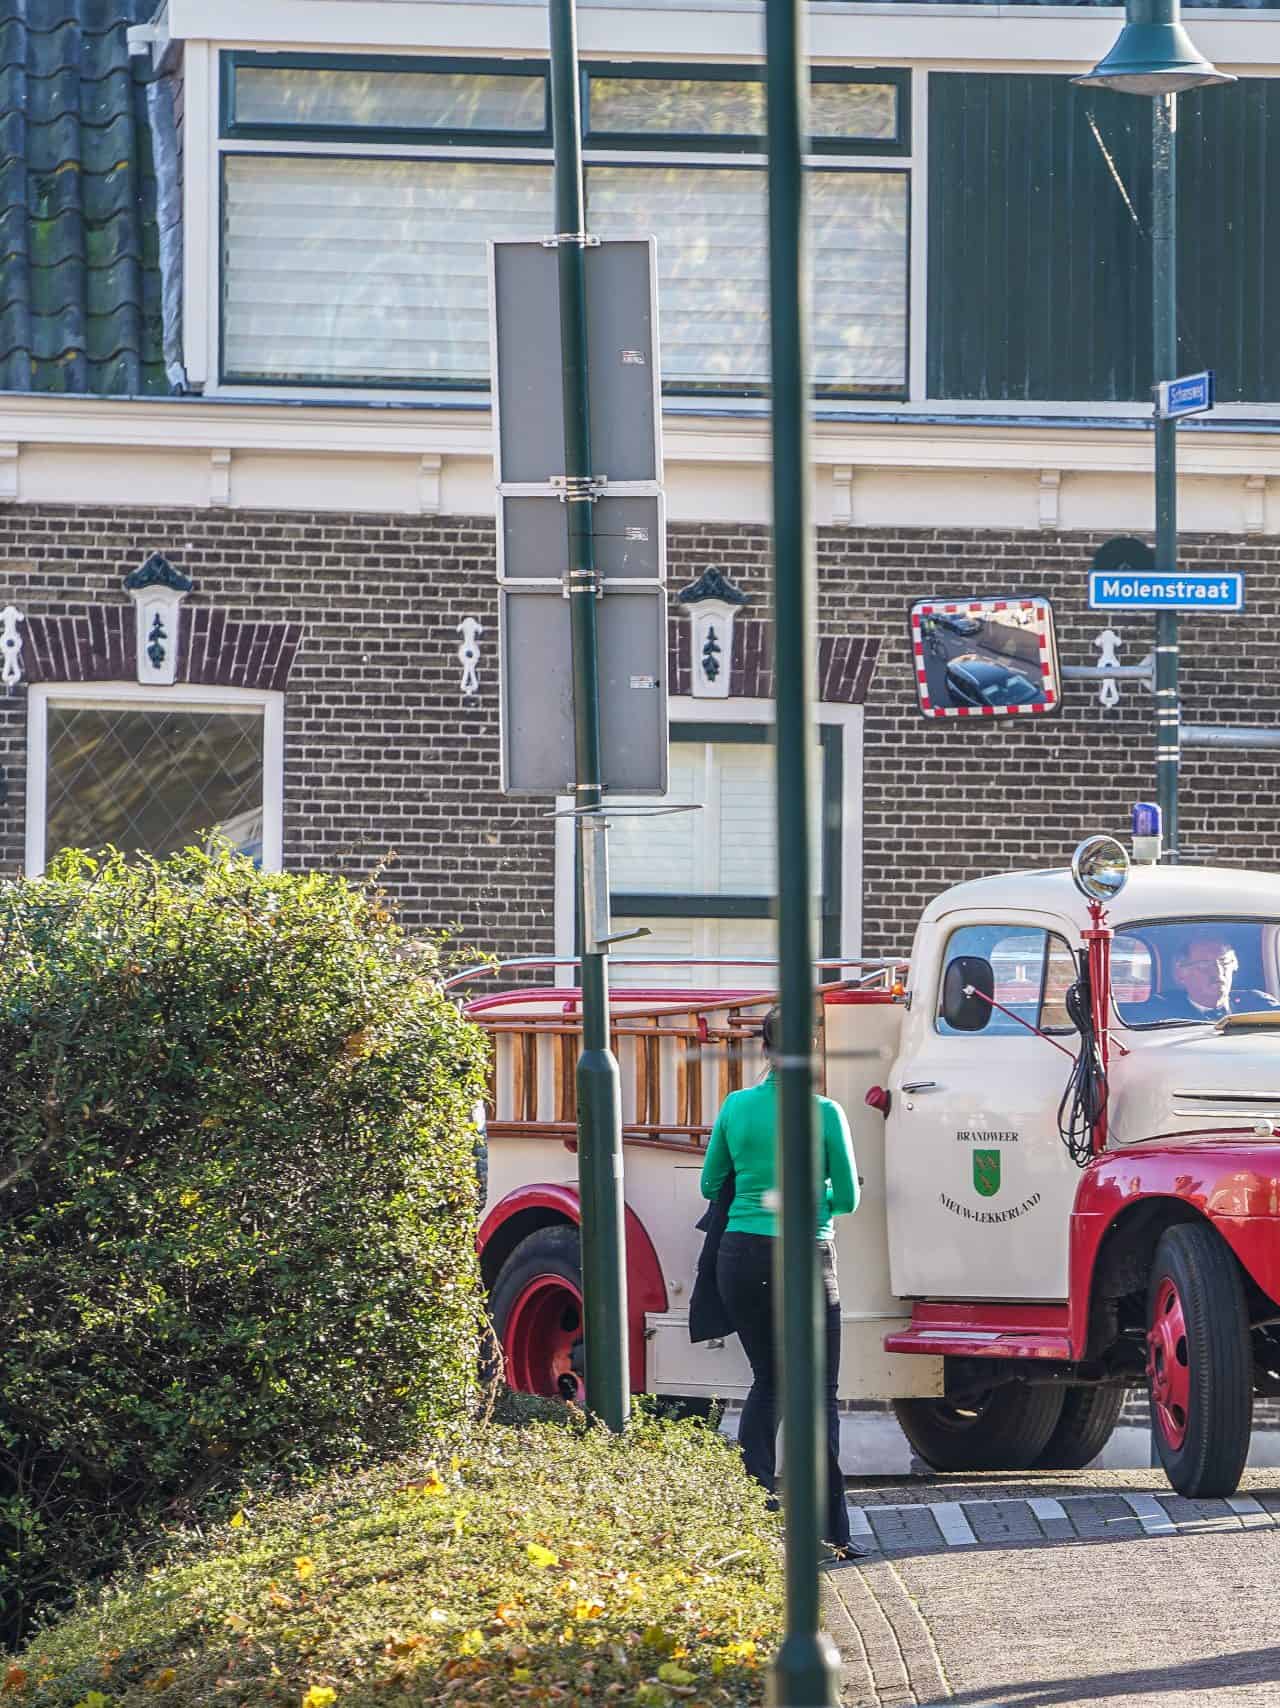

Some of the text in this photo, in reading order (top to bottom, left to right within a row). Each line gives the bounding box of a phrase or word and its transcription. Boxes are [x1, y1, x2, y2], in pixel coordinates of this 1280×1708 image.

[1102, 579, 1229, 599] Molenstraat
[956, 1131, 1019, 1142] BRANDWEER
[939, 1192, 1041, 1223] NIEUW-LEKKERLAND
